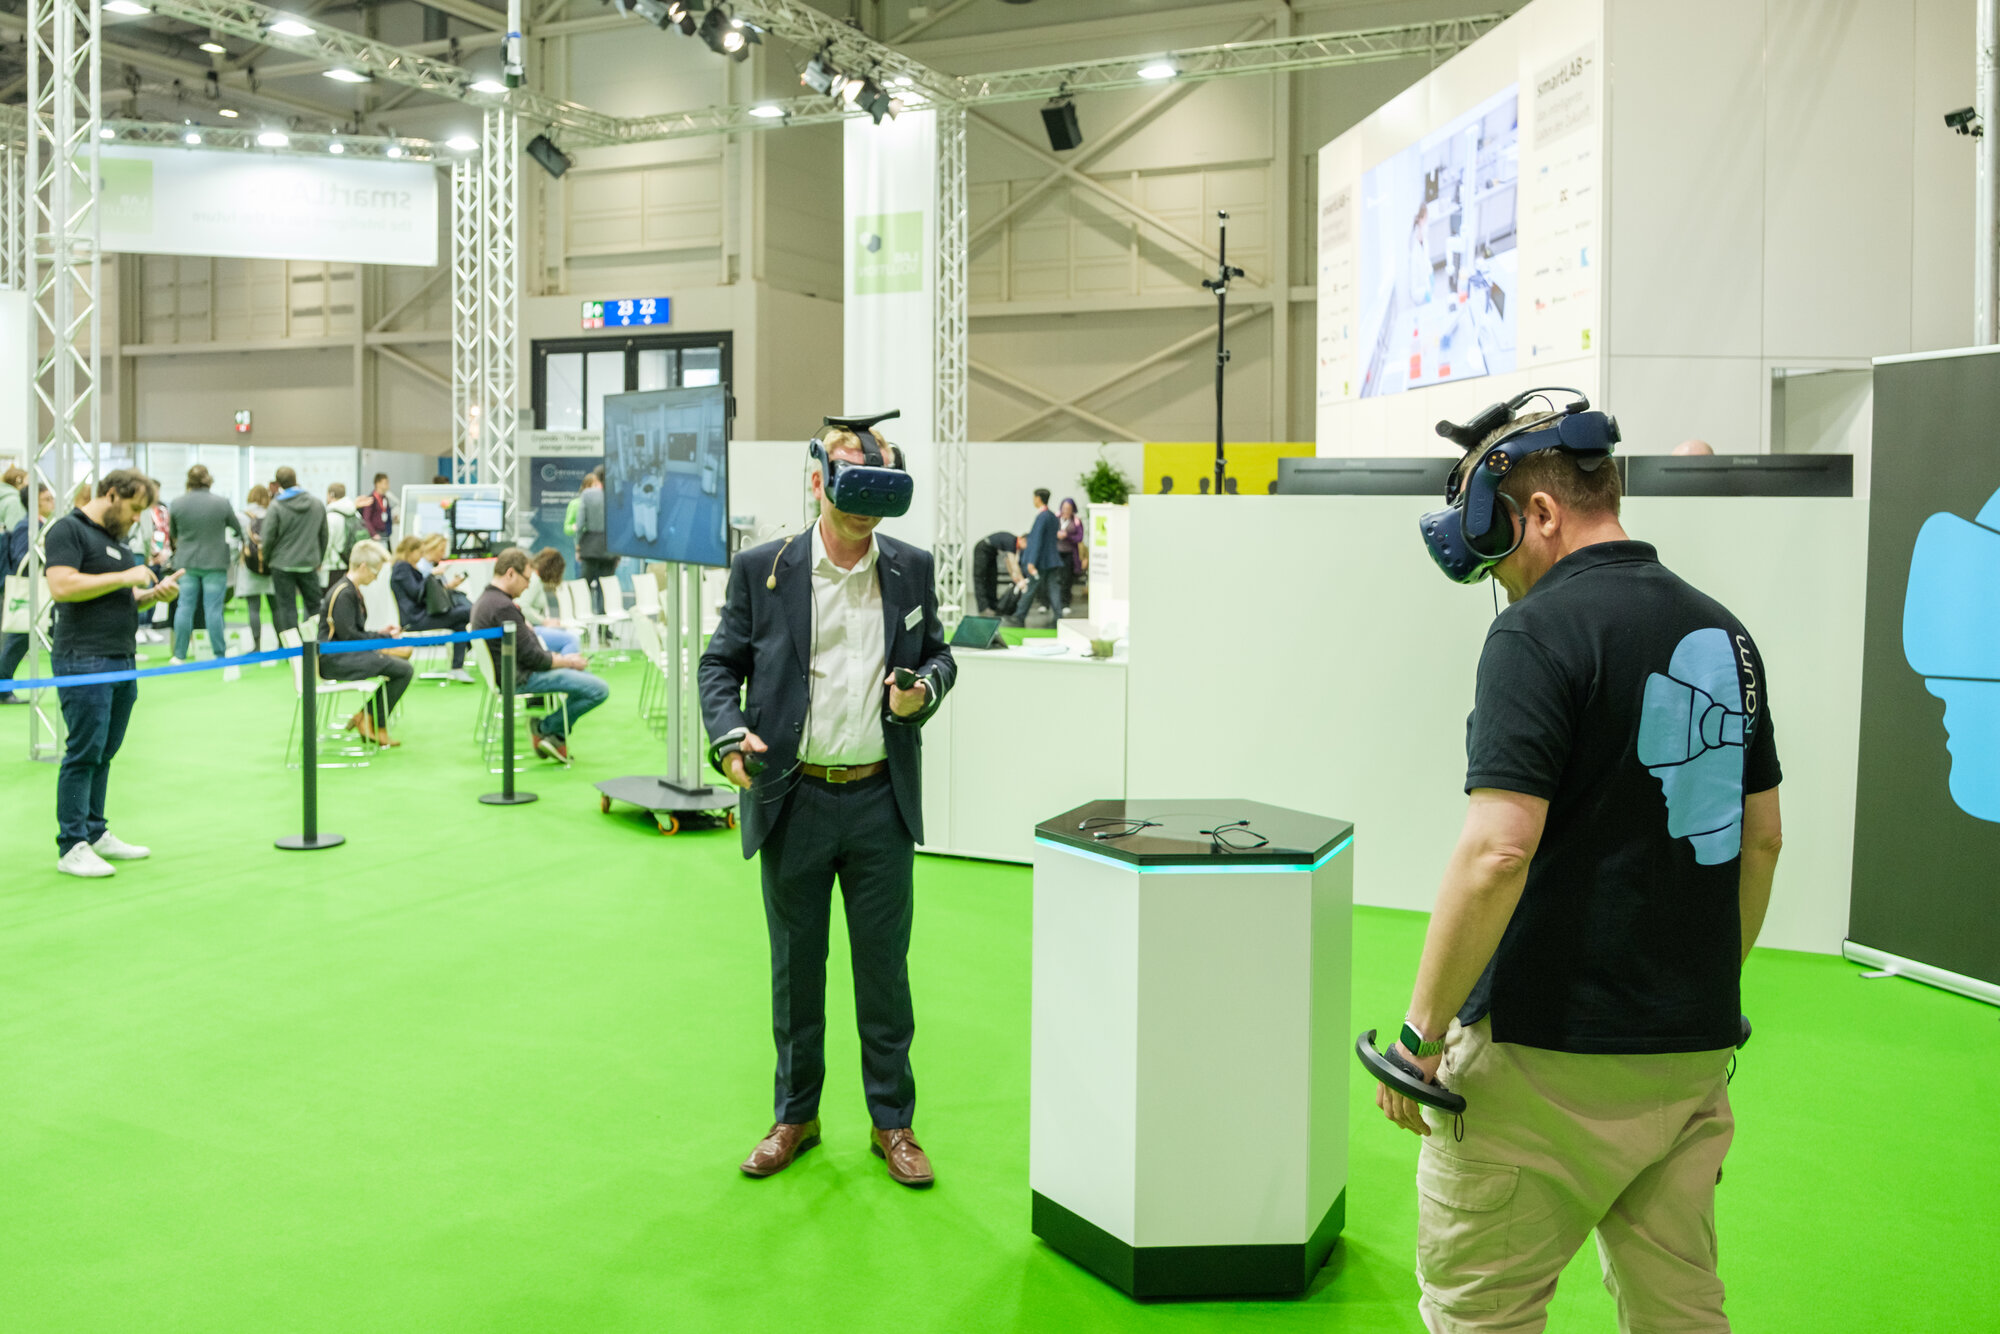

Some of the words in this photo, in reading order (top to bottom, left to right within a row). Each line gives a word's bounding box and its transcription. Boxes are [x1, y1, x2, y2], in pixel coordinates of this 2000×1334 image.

[1537, 56, 1582, 98] smartLAB
[617, 300, 634, 316] 23
[639, 298, 656, 315] 22
[1736, 635, 1756, 749] Raum
